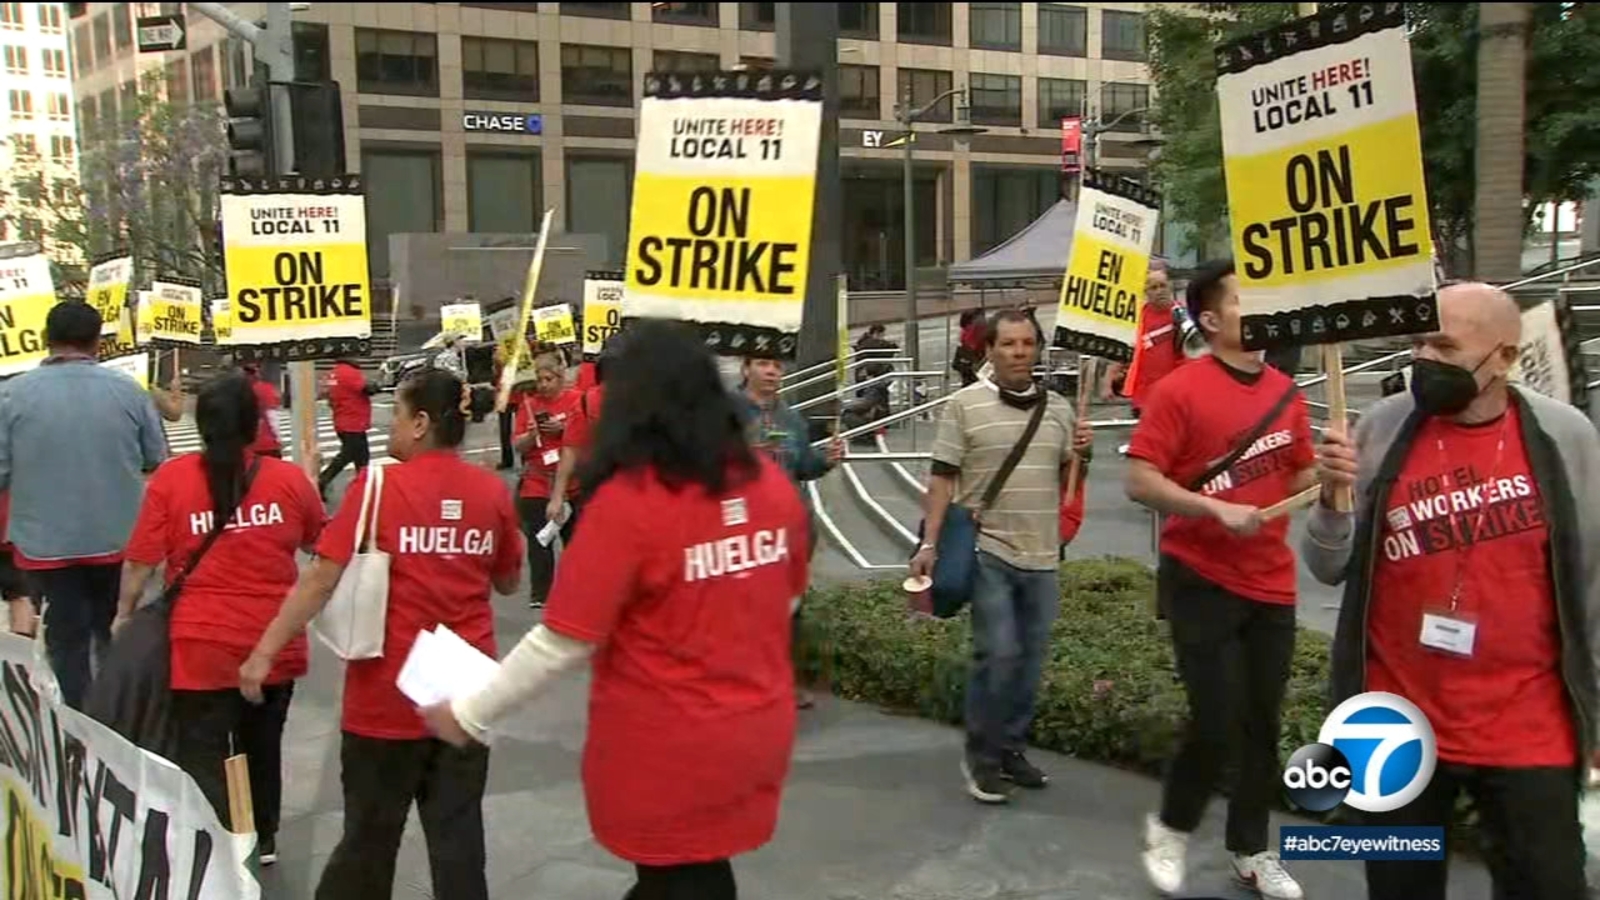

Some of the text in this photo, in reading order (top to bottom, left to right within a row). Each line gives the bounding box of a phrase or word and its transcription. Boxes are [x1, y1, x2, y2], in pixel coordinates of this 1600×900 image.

[1252, 57, 1370, 108] UNITE HERE!
[1253, 80, 1374, 134] LOCAL 11
[464, 115, 525, 131] CHASE
[673, 117, 784, 136] UNITE HERE!
[862, 130, 884, 147] EY
[669, 138, 782, 160] LOCAL 11
[1286, 144, 1354, 214] ON
[250, 206, 340, 220] UNITE HERE!
[251, 219, 340, 236] LOCAL 11
[687, 185, 751, 239] ON
[1093, 214, 1141, 245] LOCAL 11
[1241, 194, 1419, 280] STRIKE
[274, 251, 323, 287] ON
[634, 235, 798, 295] STRIKE
[1097, 250, 1123, 285] EN
[13, 277, 28, 289] 11
[168, 305, 185, 320] ON
[237, 283, 363, 323] STRIKE
[1064, 275, 1136, 323] HUELGA
[0, 305, 15, 331] N
[154, 316, 199, 335] STRIKE
[607, 309, 620, 326] O
[400, 526, 493, 555] HUELGA
[684, 527, 788, 582] HUELGA
[1384, 530, 1420, 562] ON
